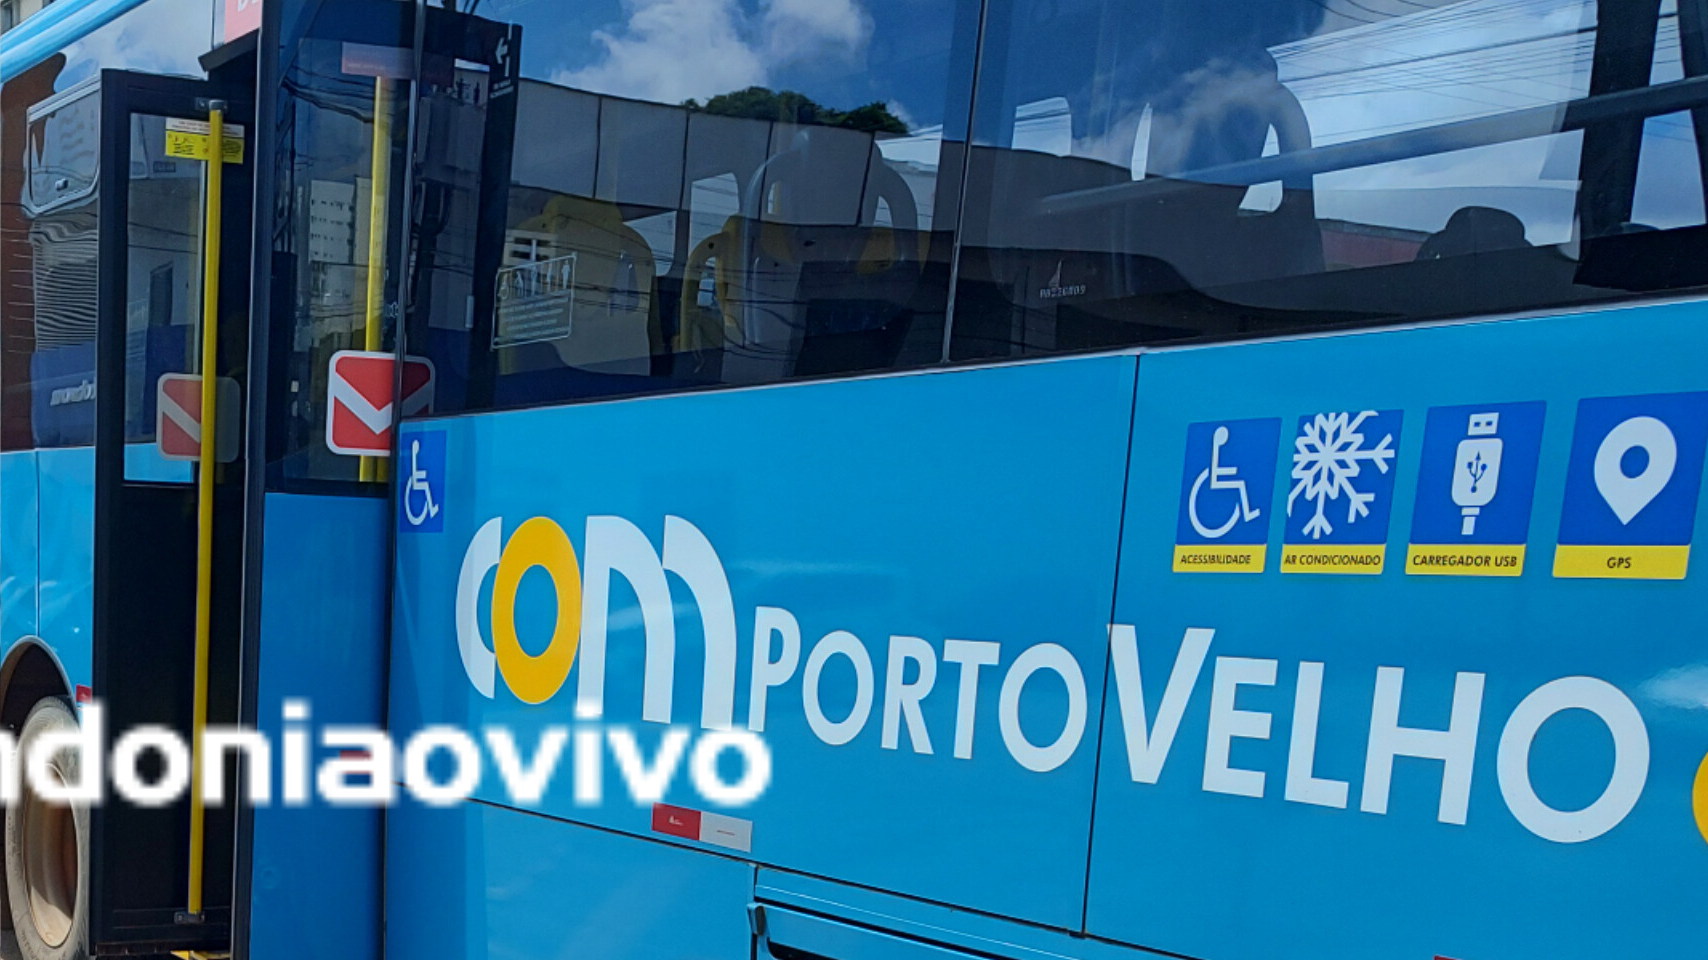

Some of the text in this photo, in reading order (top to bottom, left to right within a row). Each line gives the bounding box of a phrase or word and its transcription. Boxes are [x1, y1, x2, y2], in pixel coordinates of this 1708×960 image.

[1180, 554, 1252, 565] ACESSIBILIDADE
[1283, 554, 1382, 566] AR CONDICIONADO
[1412, 554, 1518, 568] CARREGADOR USB
[1606, 556, 1633, 569] GPS
[748, 605, 1089, 773] PORTO
[1107, 623, 1651, 845] VELHO
